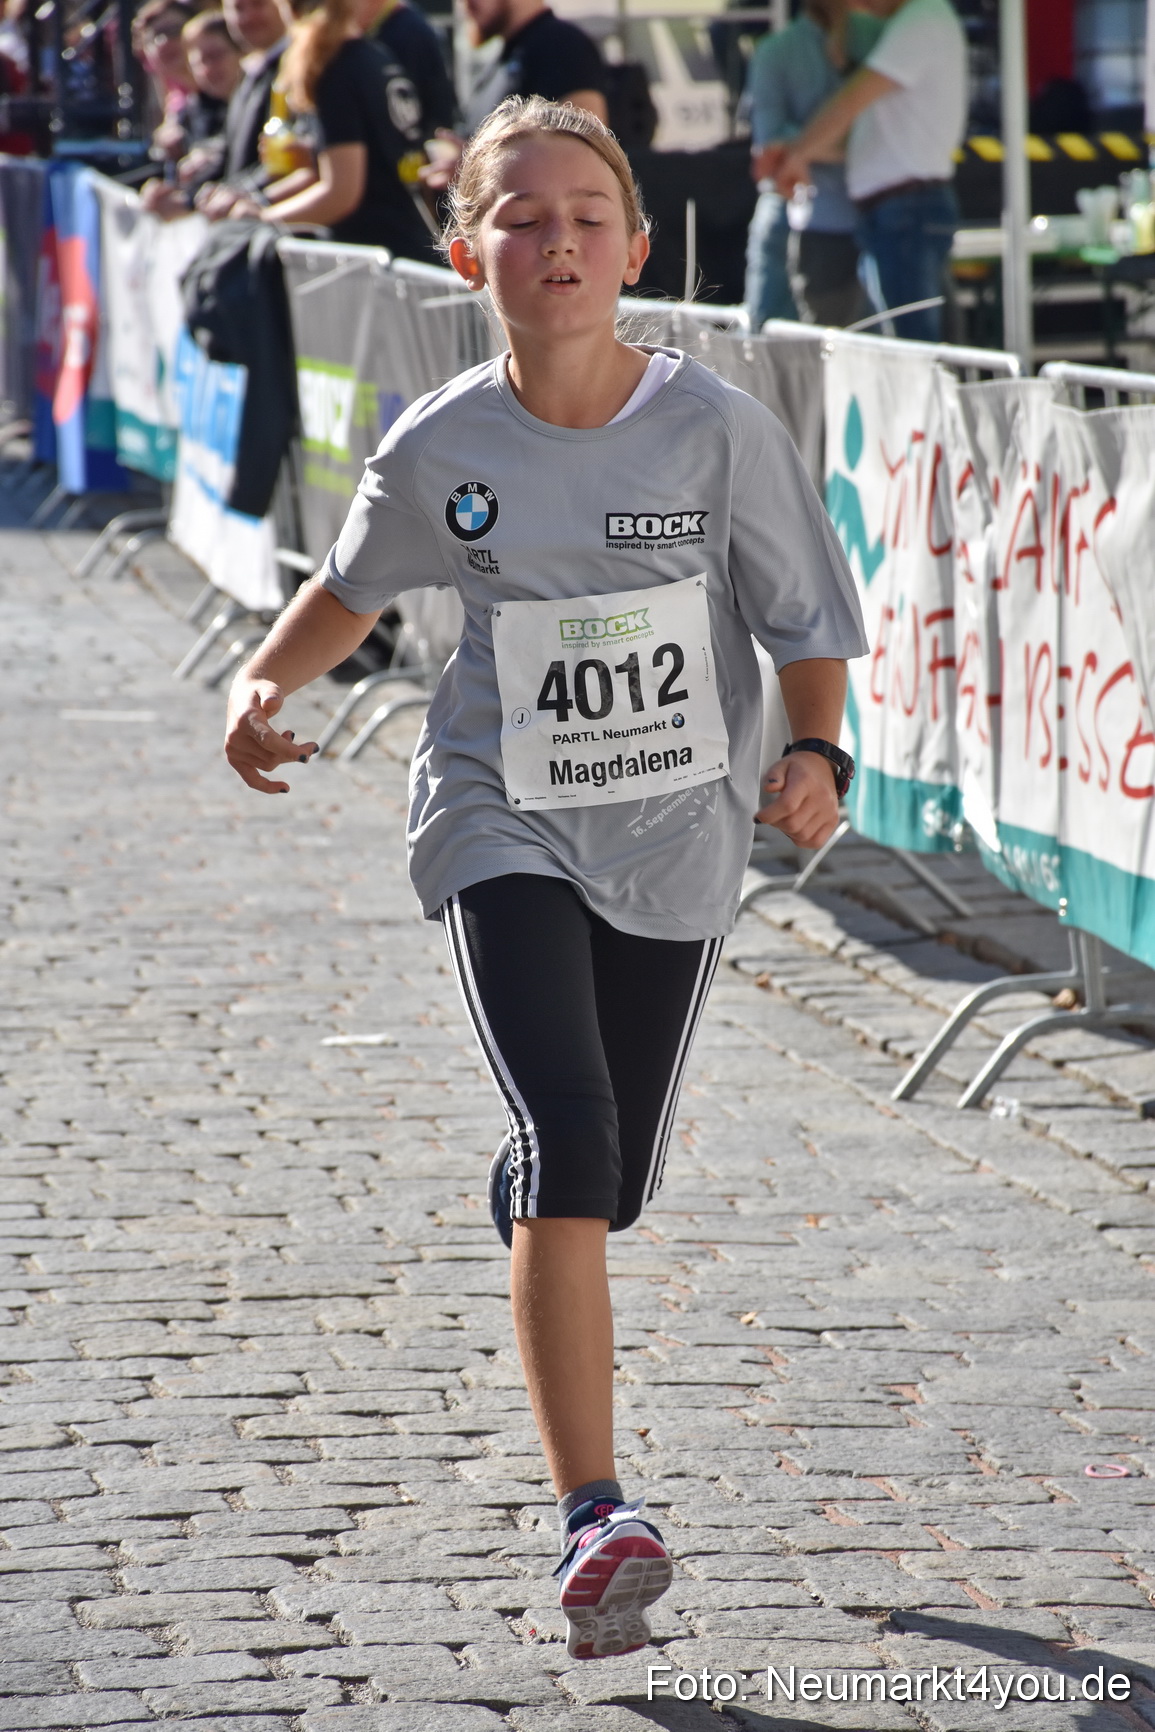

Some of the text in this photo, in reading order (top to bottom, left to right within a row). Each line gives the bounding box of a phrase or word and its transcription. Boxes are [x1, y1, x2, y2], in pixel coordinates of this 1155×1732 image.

[450, 482, 496, 503] BMW
[605, 510, 710, 540] BOCK
[605, 536, 705, 551] inspired by smart concepts
[559, 606, 653, 641] BOCK
[561, 629, 655, 650] inspired by smart concepts
[536, 642, 690, 723] 4012
[552, 720, 668, 745] PARTL Neumarkt
[549, 746, 693, 788] Magdalena
[631, 826, 648, 838] 16.
